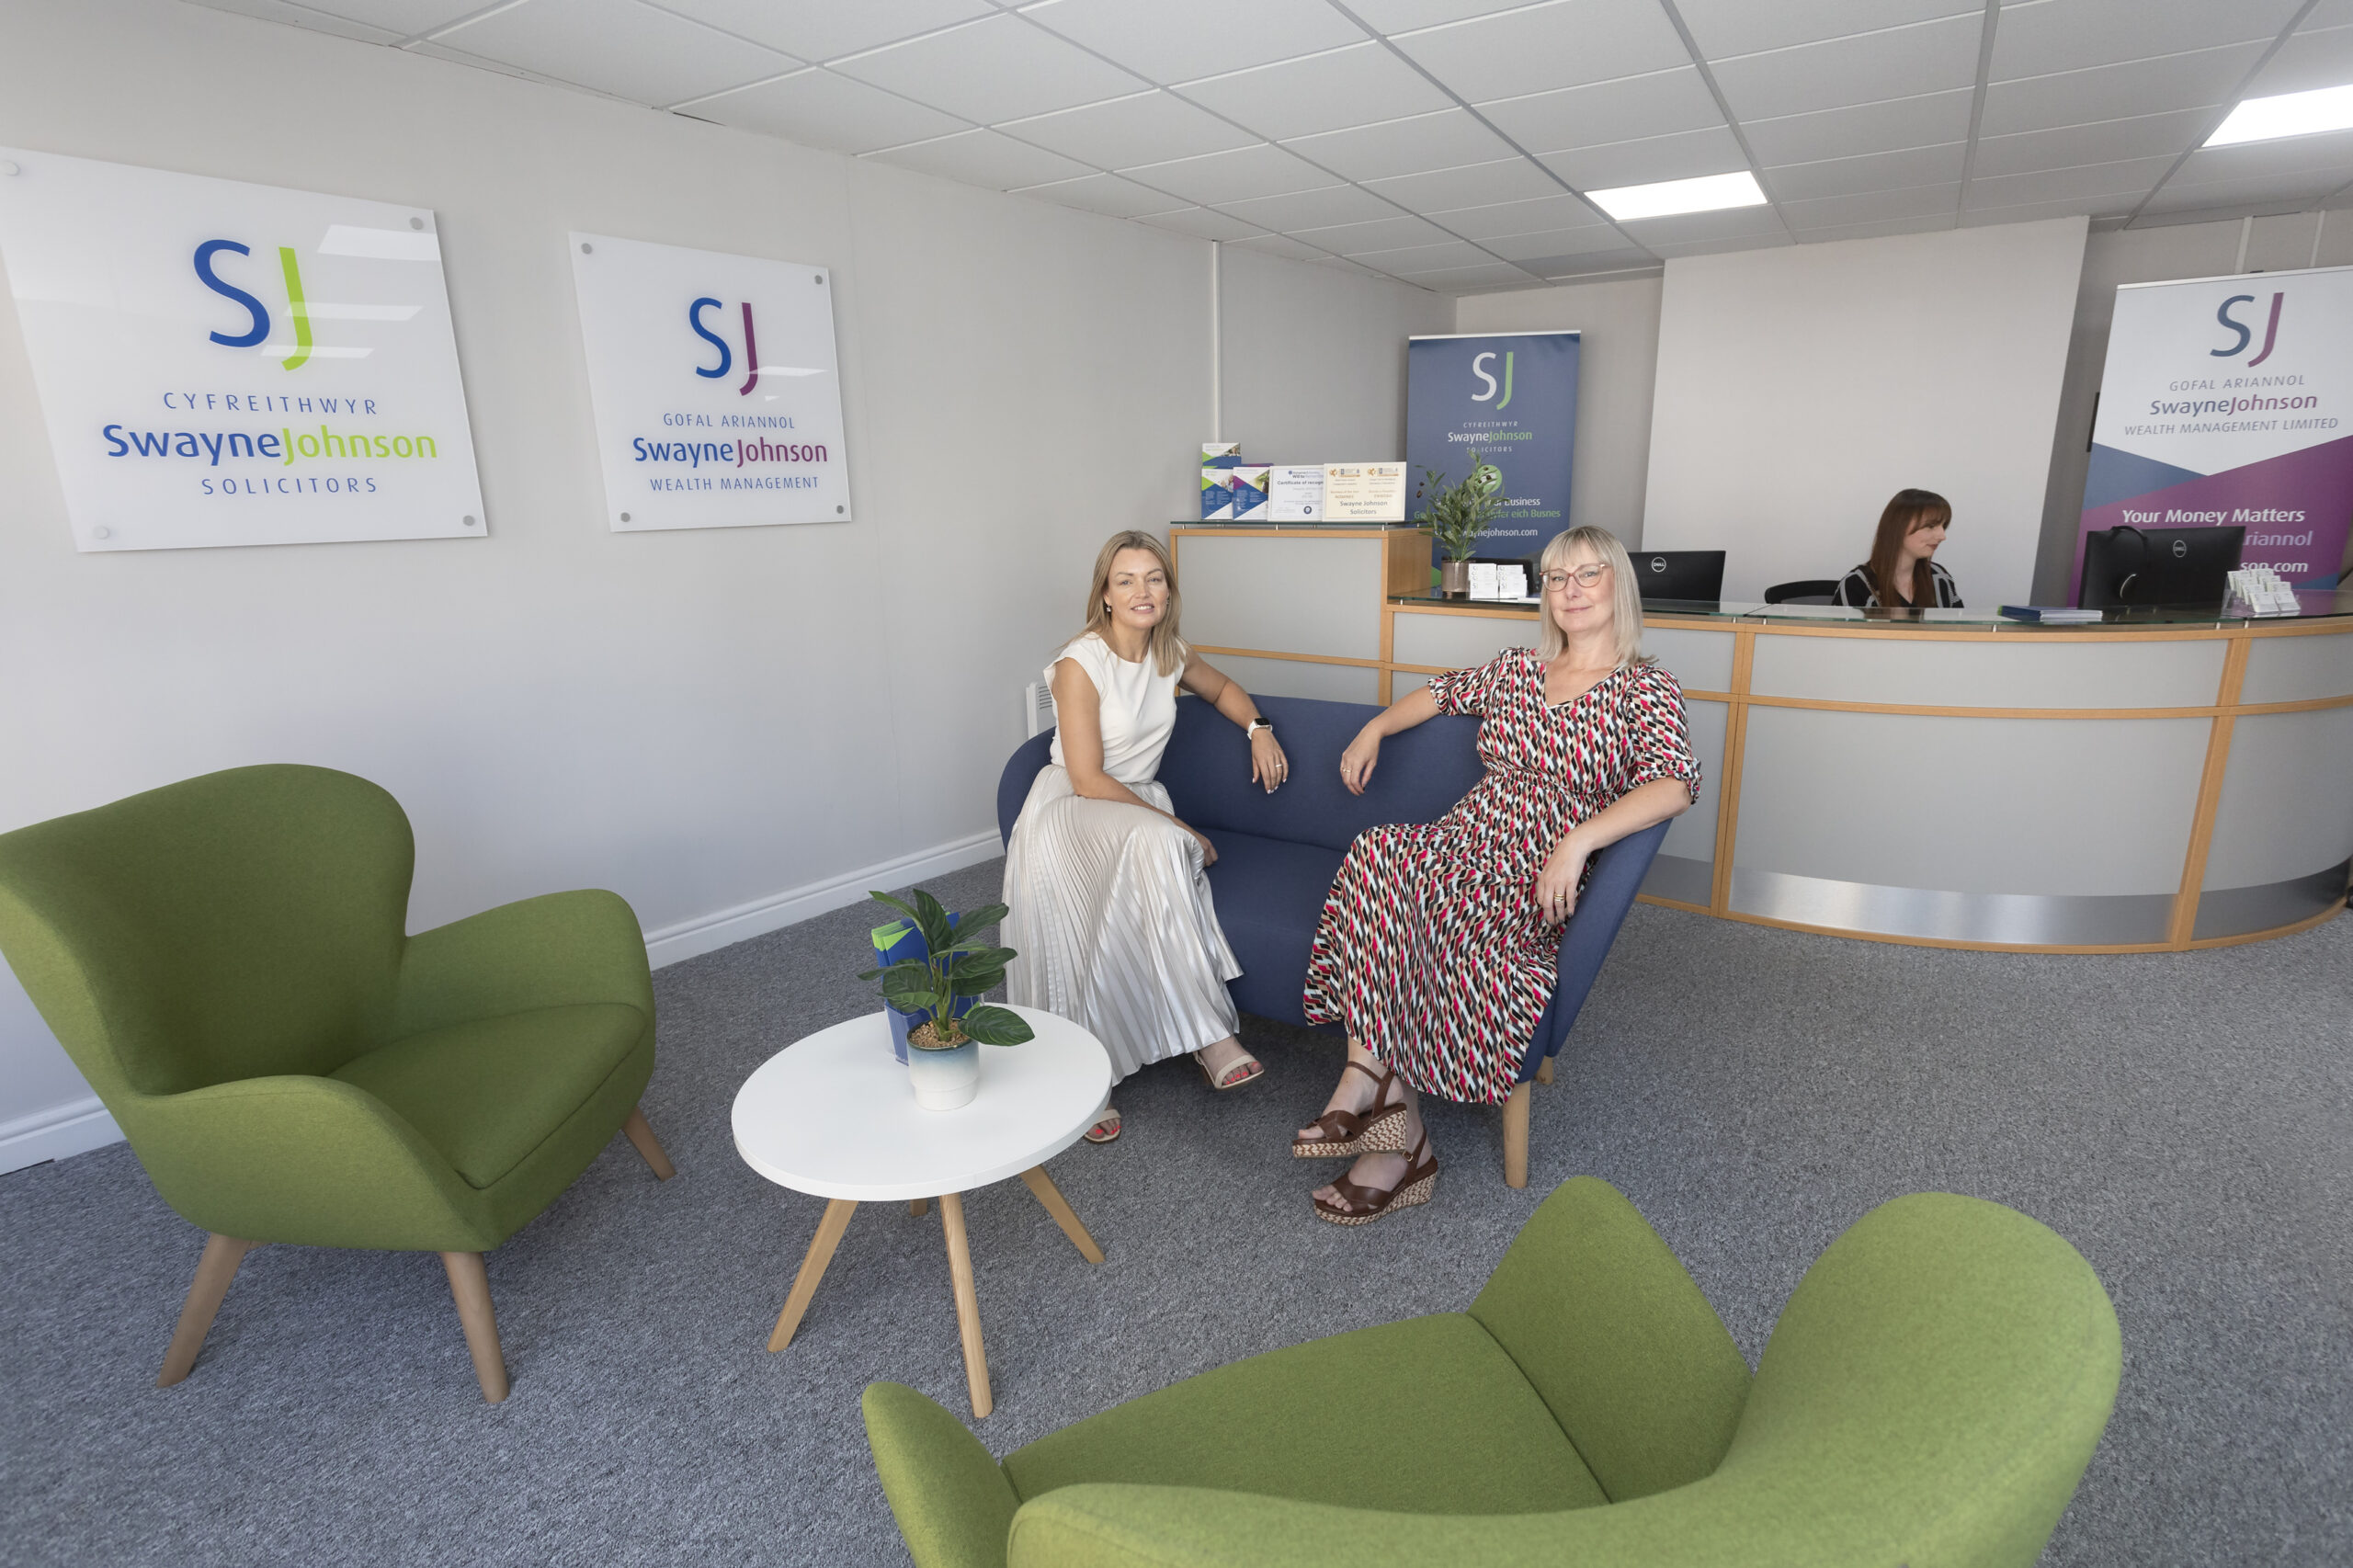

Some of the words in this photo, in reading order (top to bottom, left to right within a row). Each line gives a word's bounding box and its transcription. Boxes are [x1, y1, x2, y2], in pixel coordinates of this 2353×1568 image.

[193, 239, 313, 371] SJ
[2209, 291, 2285, 369] SJ
[688, 297, 758, 396] SJ
[1471, 351, 1514, 410] SJ
[2169, 380, 2216, 392] GOFAL
[2222, 374, 2305, 390] ARIANNOL
[163, 392, 378, 415] CYFREITHWYR
[2149, 393, 2318, 417] SwayneJohnson
[663, 413, 713, 427] GOFAL
[722, 415, 795, 429] ARIANNOL
[1462, 420, 1518, 428] CYFREITHWYR
[2124, 424, 2175, 437] WEALTH
[2180, 420, 2279, 434] MANAGEMENT
[2283, 417, 2339, 430] LIMITED
[102, 423, 438, 466] SwayneJohnson
[1448, 429, 1533, 445] SwayneJohnson
[632, 436, 828, 469] SwayneJohnson
[1466, 446, 1513, 454] SOICITORS
[200, 477, 378, 495] SOLICITORS
[650, 478, 712, 492] WEALTH
[721, 476, 819, 491] MANAGEMENT
[1511, 508, 1529, 518] eich
[1530, 508, 1561, 518] Busnes
[2122, 509, 2161, 523] Your
[2165, 509, 2227, 526] Money
[2232, 507, 2306, 522] Matters
[2243, 530, 2313, 546] riannol
